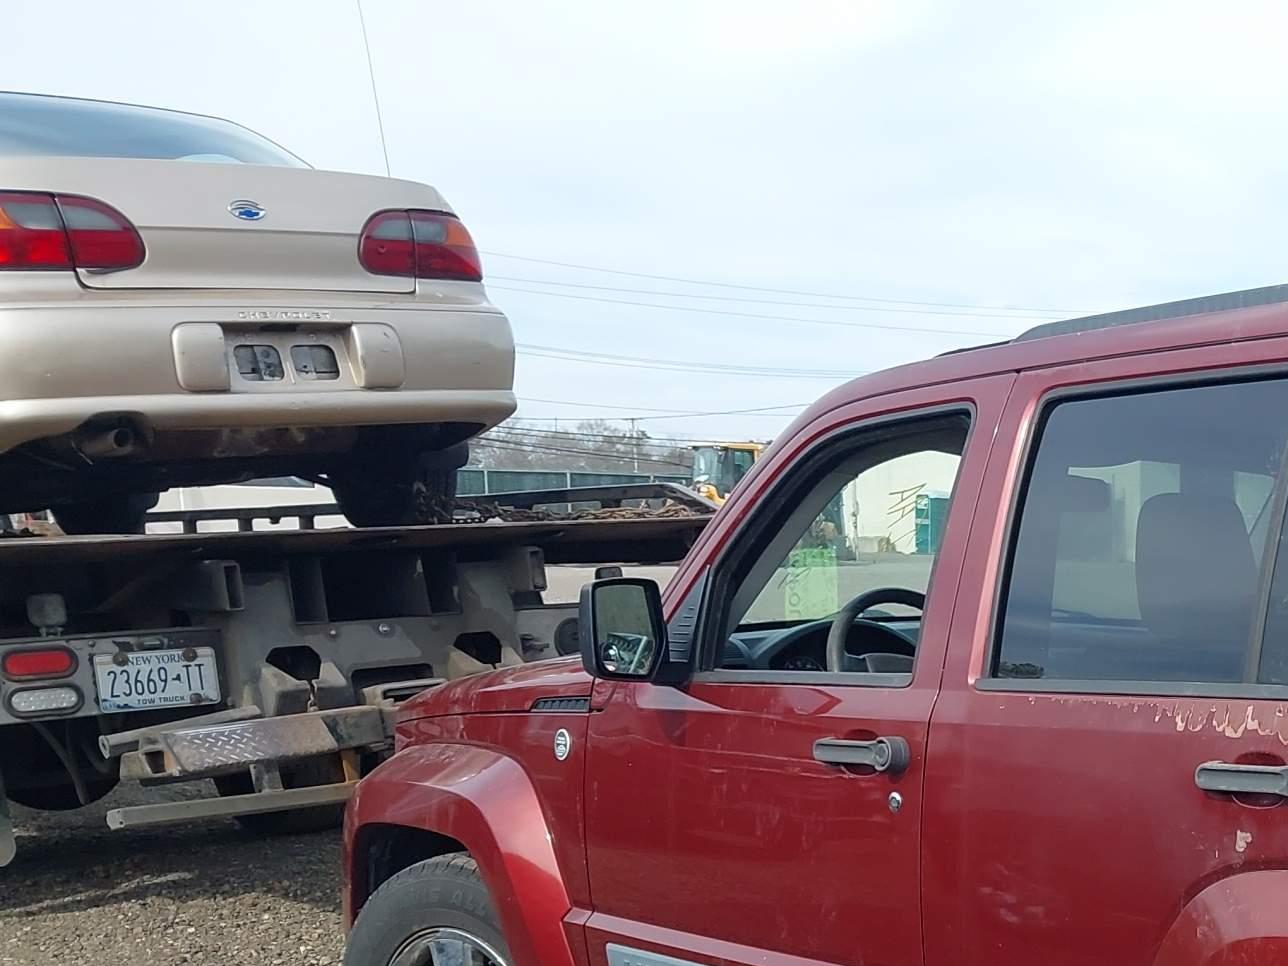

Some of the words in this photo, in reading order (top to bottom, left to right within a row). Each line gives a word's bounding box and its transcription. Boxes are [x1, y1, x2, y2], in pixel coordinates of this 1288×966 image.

[128, 655, 152, 666] NEW
[107, 666, 168, 698] 23669
[137, 697, 156, 705] TOW
